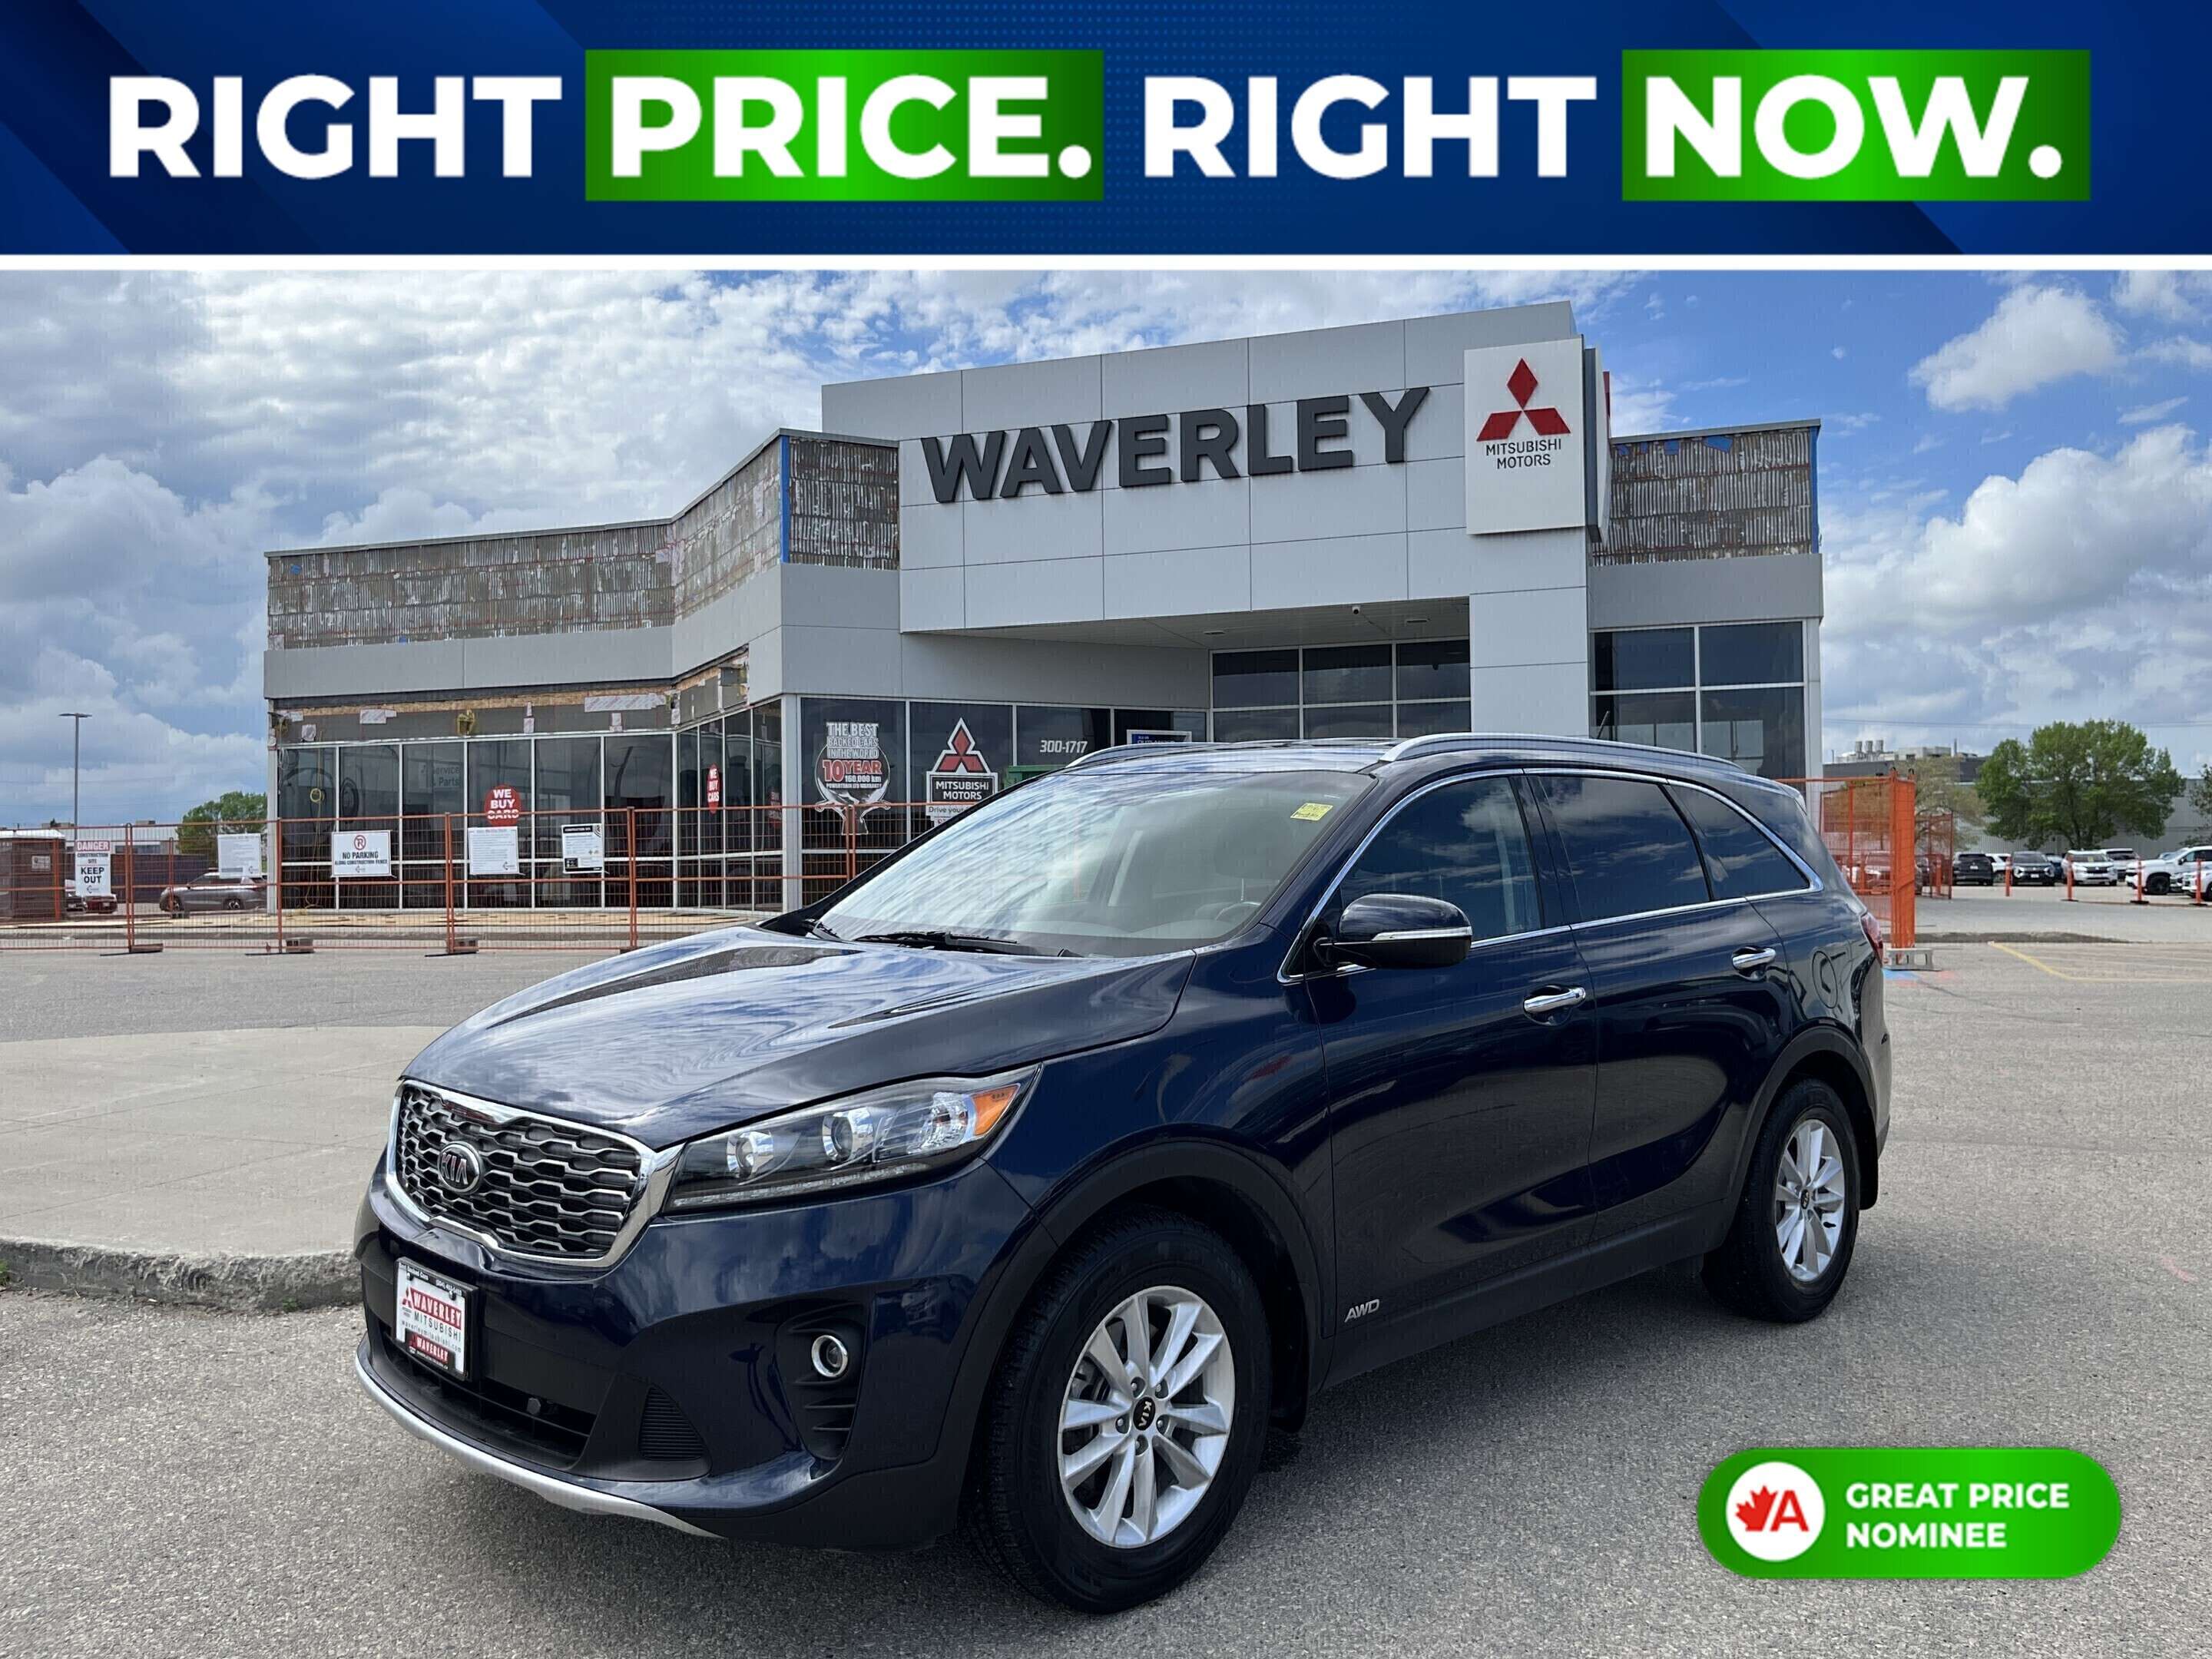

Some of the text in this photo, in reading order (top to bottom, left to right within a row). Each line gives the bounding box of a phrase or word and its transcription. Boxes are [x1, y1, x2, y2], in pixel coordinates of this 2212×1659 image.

[921, 386, 1431, 503] WAVERLEY
[1485, 438, 1562, 456] MITSUBISHI
[1497, 453, 1551, 469] MOTORS
[826, 722, 879, 737] THE BEST
[827, 737, 879, 747] BACKED CARS
[1039, 740, 1088, 753] 300-1717
[823, 760, 882, 782] 10 YEAR
[935, 780, 989, 790] MITSUBISHI
[493, 789, 512, 799] WE
[942, 790, 982, 800] MOTORS
[490, 799, 515, 809] BUY
[77, 841, 109, 851] DANGER
[352, 850, 379, 859] PARKING
[81, 866, 104, 875] KEEP
[84, 876, 102, 884] OUT
[441, 1151, 469, 1185] KIA
[413, 1290, 462, 1328] WAVERLEY
[1344, 1298, 1380, 1323] AWD
[414, 1310, 462, 1343] MITSUBISHI
[416, 1336, 449, 1363] WAVERLEY
[1137, 1401, 1152, 1427] KIA
